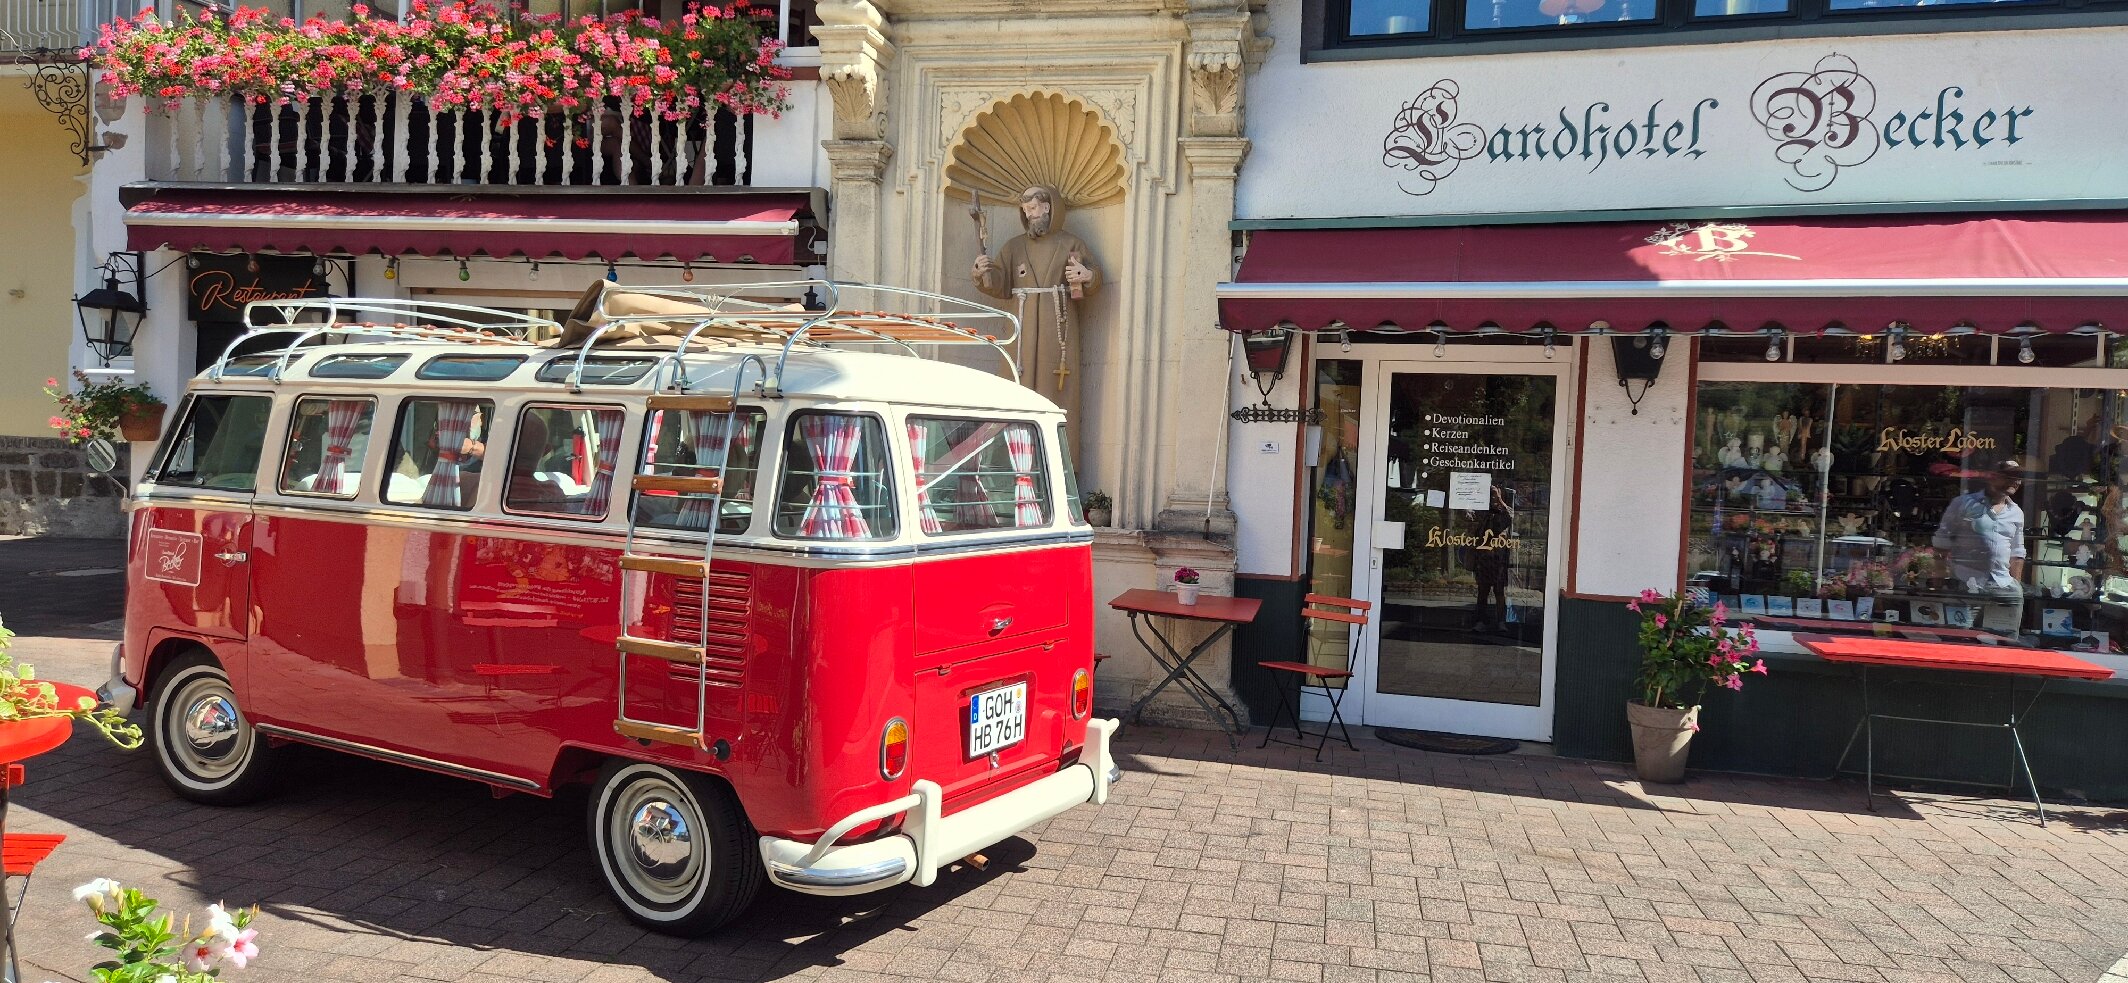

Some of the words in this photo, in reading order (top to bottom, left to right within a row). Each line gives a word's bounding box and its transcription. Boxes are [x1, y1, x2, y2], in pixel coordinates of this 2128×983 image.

[1383, 79, 1719, 195] Landhotel
[1750, 52, 2034, 192] Becker
[191, 270, 317, 311] Restaurant
[1433, 413, 1504, 426] Devotionalien
[1432, 428, 1469, 439] Kerzen
[1876, 427, 1943, 452] Kloster
[1940, 428, 1996, 453] Laden
[1430, 442, 1509, 455] Reiseandenken
[1430, 457, 1515, 470] Geschenkartikel
[1425, 526, 1479, 548] Kloster
[1476, 528, 1521, 551] Laden
[985, 690, 1012, 720] GOH
[974, 723, 992, 752] HB
